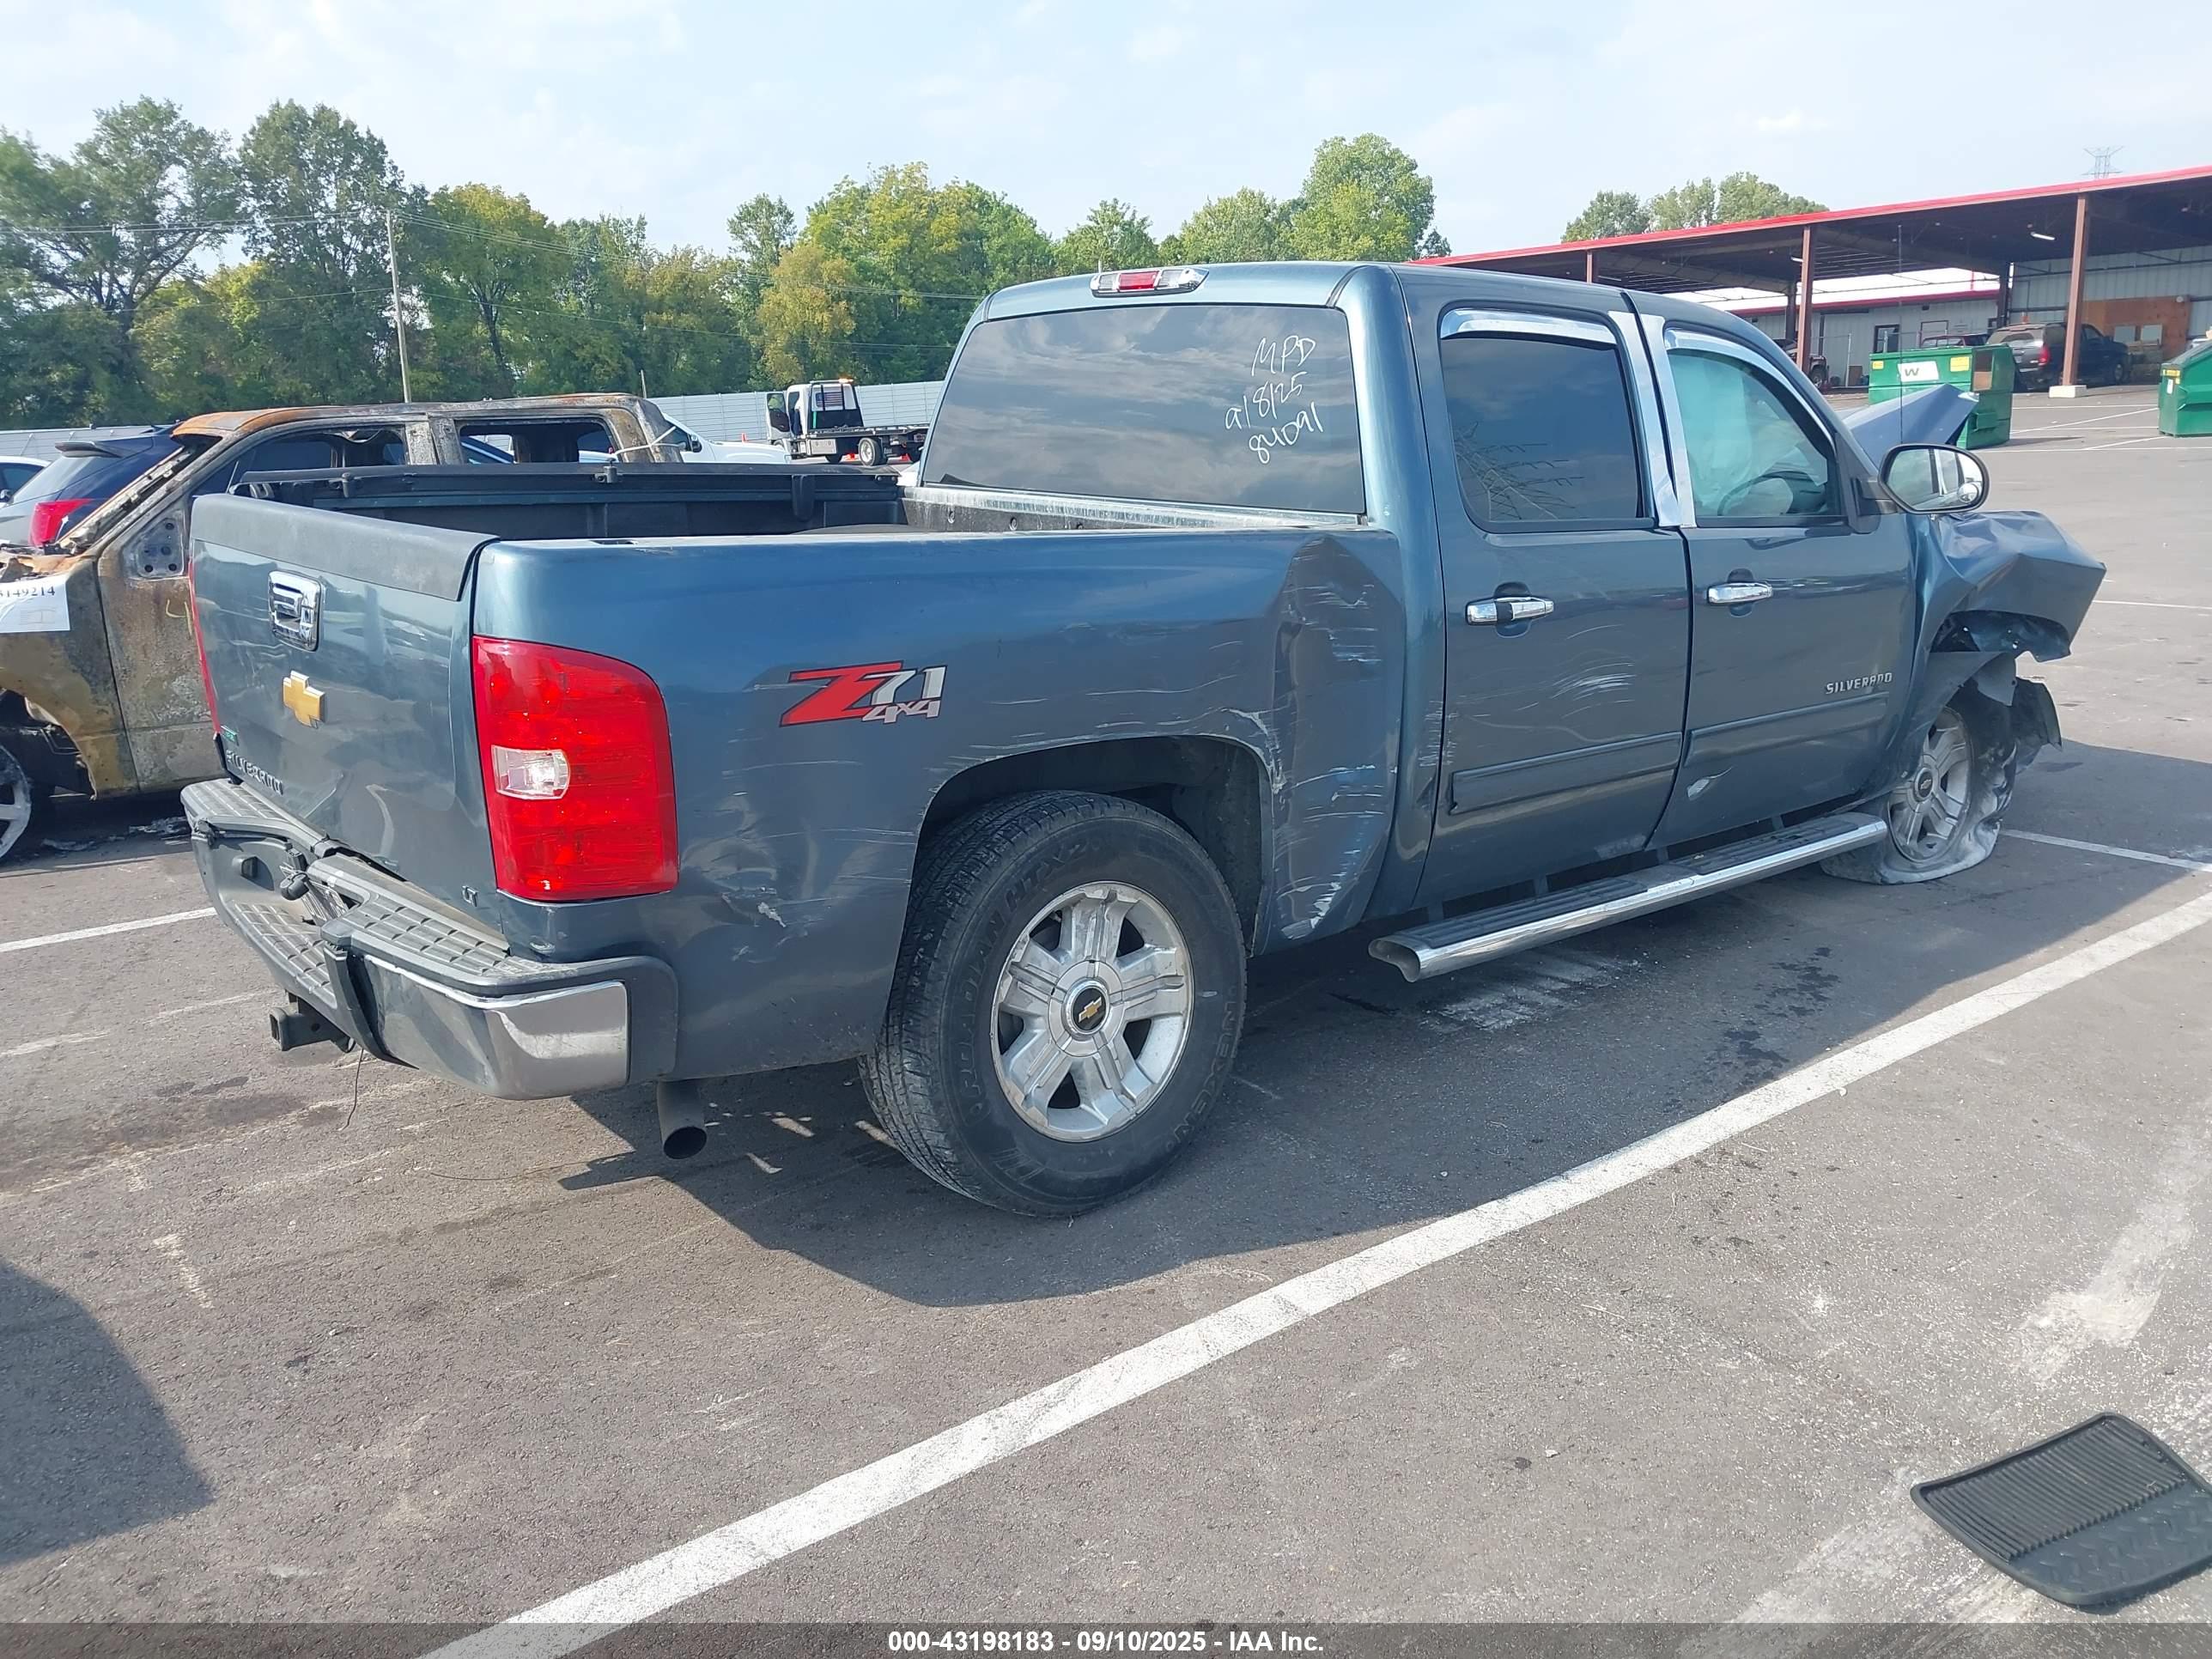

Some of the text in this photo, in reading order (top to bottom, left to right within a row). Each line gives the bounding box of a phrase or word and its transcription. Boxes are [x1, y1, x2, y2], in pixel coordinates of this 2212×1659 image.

[1251, 335, 1316, 377] MPD
[779, 659, 948, 727] Z71
[1825, 672, 1893, 695] SILVERADO
